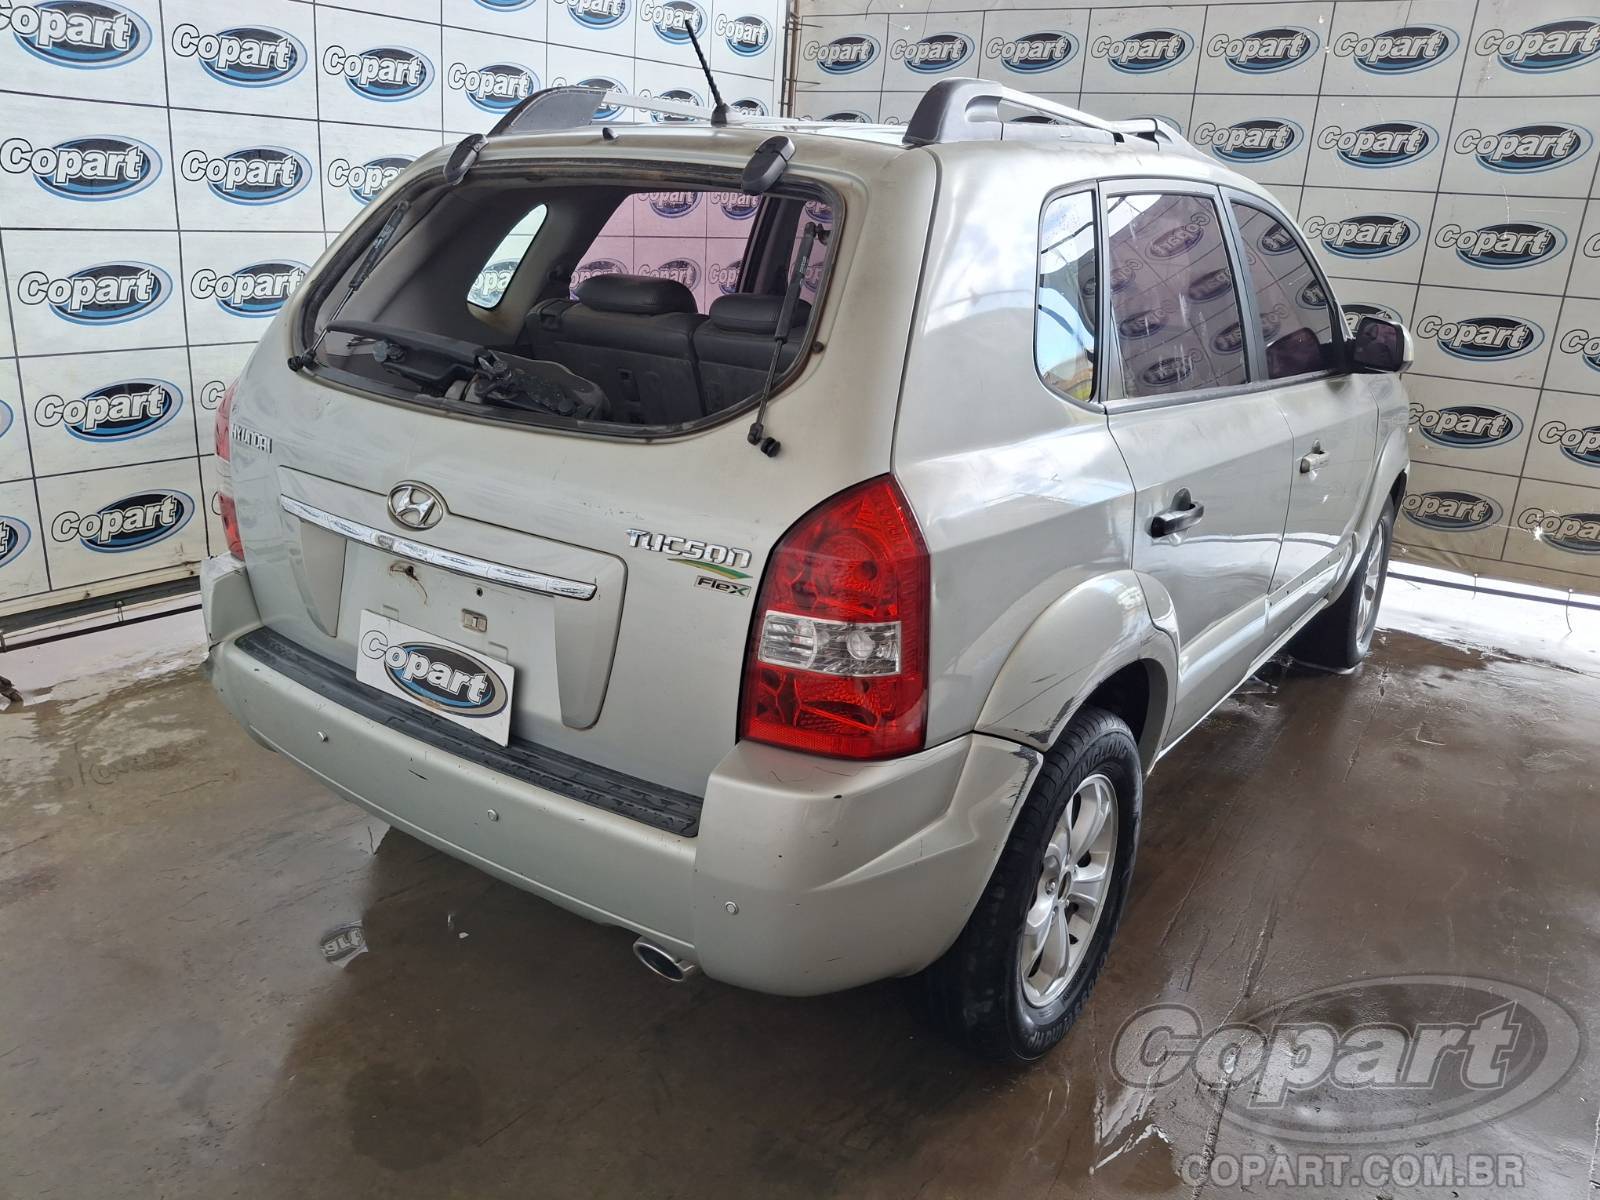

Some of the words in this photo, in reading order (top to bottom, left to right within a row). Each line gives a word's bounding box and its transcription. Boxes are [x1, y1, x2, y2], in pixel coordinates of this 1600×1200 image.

[714, 14, 767, 44] Copart
[172, 24, 291, 70] Copart
[804, 39, 873, 63] Copart
[891, 37, 965, 63] Copart
[986, 37, 1067, 64] Copart
[1091, 35, 1181, 63] Copart
[1207, 32, 1306, 65] Copart
[1334, 31, 1447, 64] Copart
[323, 45, 421, 86] Copart
[448, 62, 529, 97] Copart
[1194, 122, 1290, 154] Copart
[1318, 126, 1430, 156] Copart
[1454, 129, 1577, 162] Copart
[0, 138, 143, 184] Copart
[181, 150, 298, 190] Copart
[328, 159, 401, 196] Copa
[1303, 216, 1411, 246] Copart
[1435, 224, 1551, 256] Copart
[18, 268, 154, 312] Copart
[1417, 315, 1529, 349] Copart
[35, 385, 166, 430] Copart
[1538, 421, 1600, 455] Cop
[51, 494, 178, 544] Copart
[1402, 494, 1488, 521] opart
[1518, 508, 1600, 540] Copa
[361, 630, 489, 704] Copart
